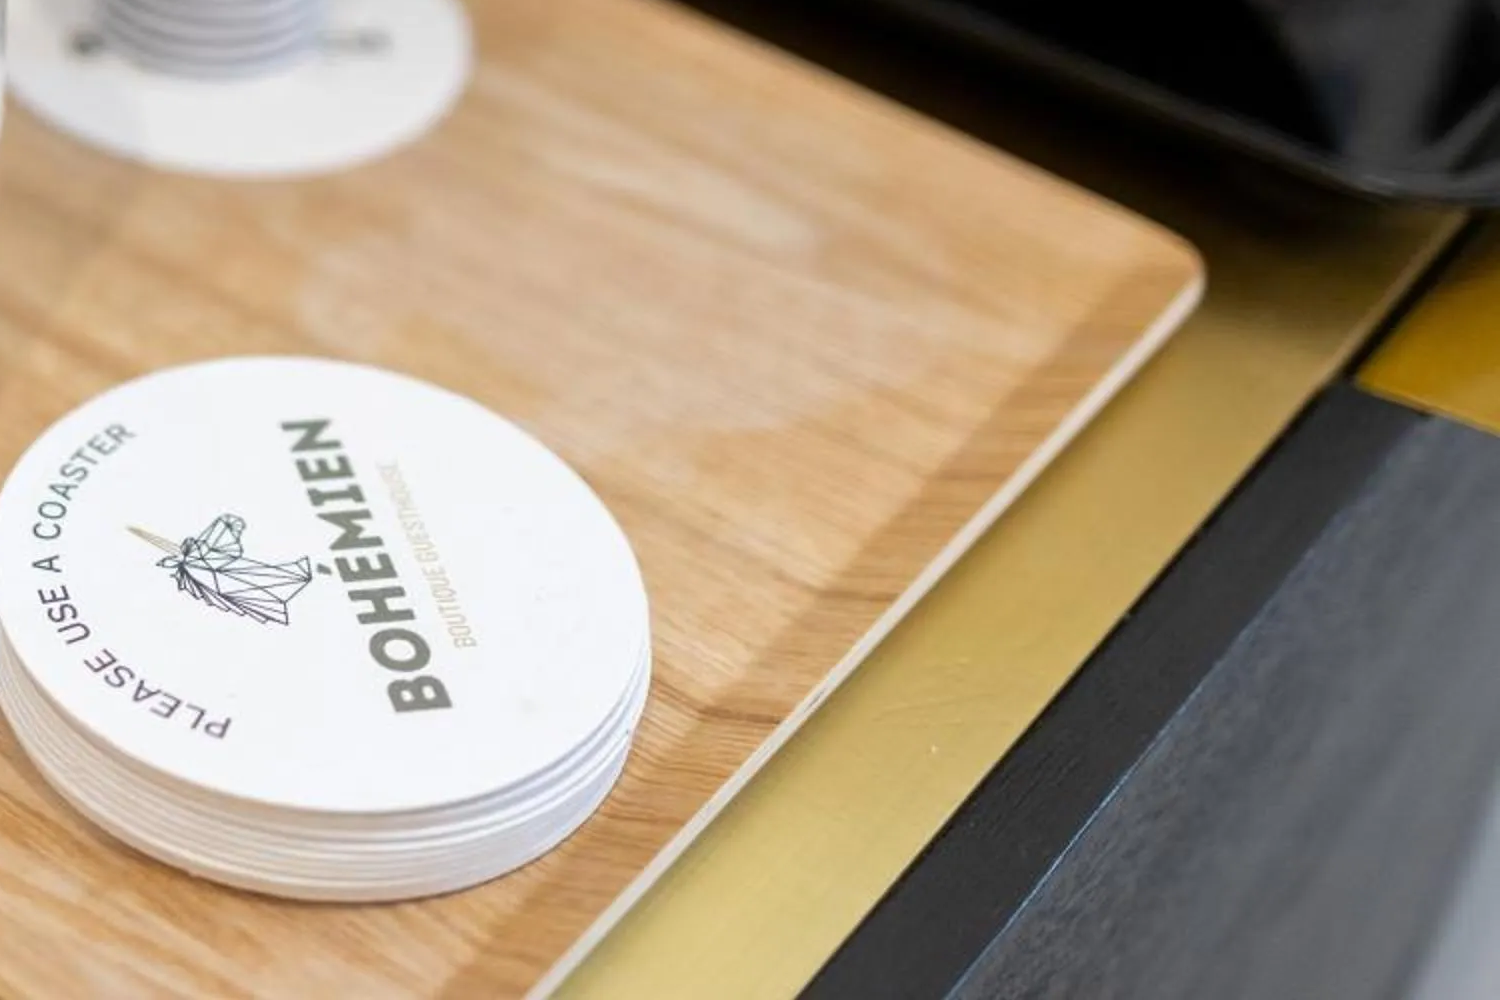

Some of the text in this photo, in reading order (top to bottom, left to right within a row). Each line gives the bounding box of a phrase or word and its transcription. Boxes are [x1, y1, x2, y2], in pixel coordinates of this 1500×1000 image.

[31, 423, 232, 739] PLEASE USE A COASTER
[280, 418, 453, 713] BOHÉMIEN
[420, 565, 478, 650] BOUTIQUE
